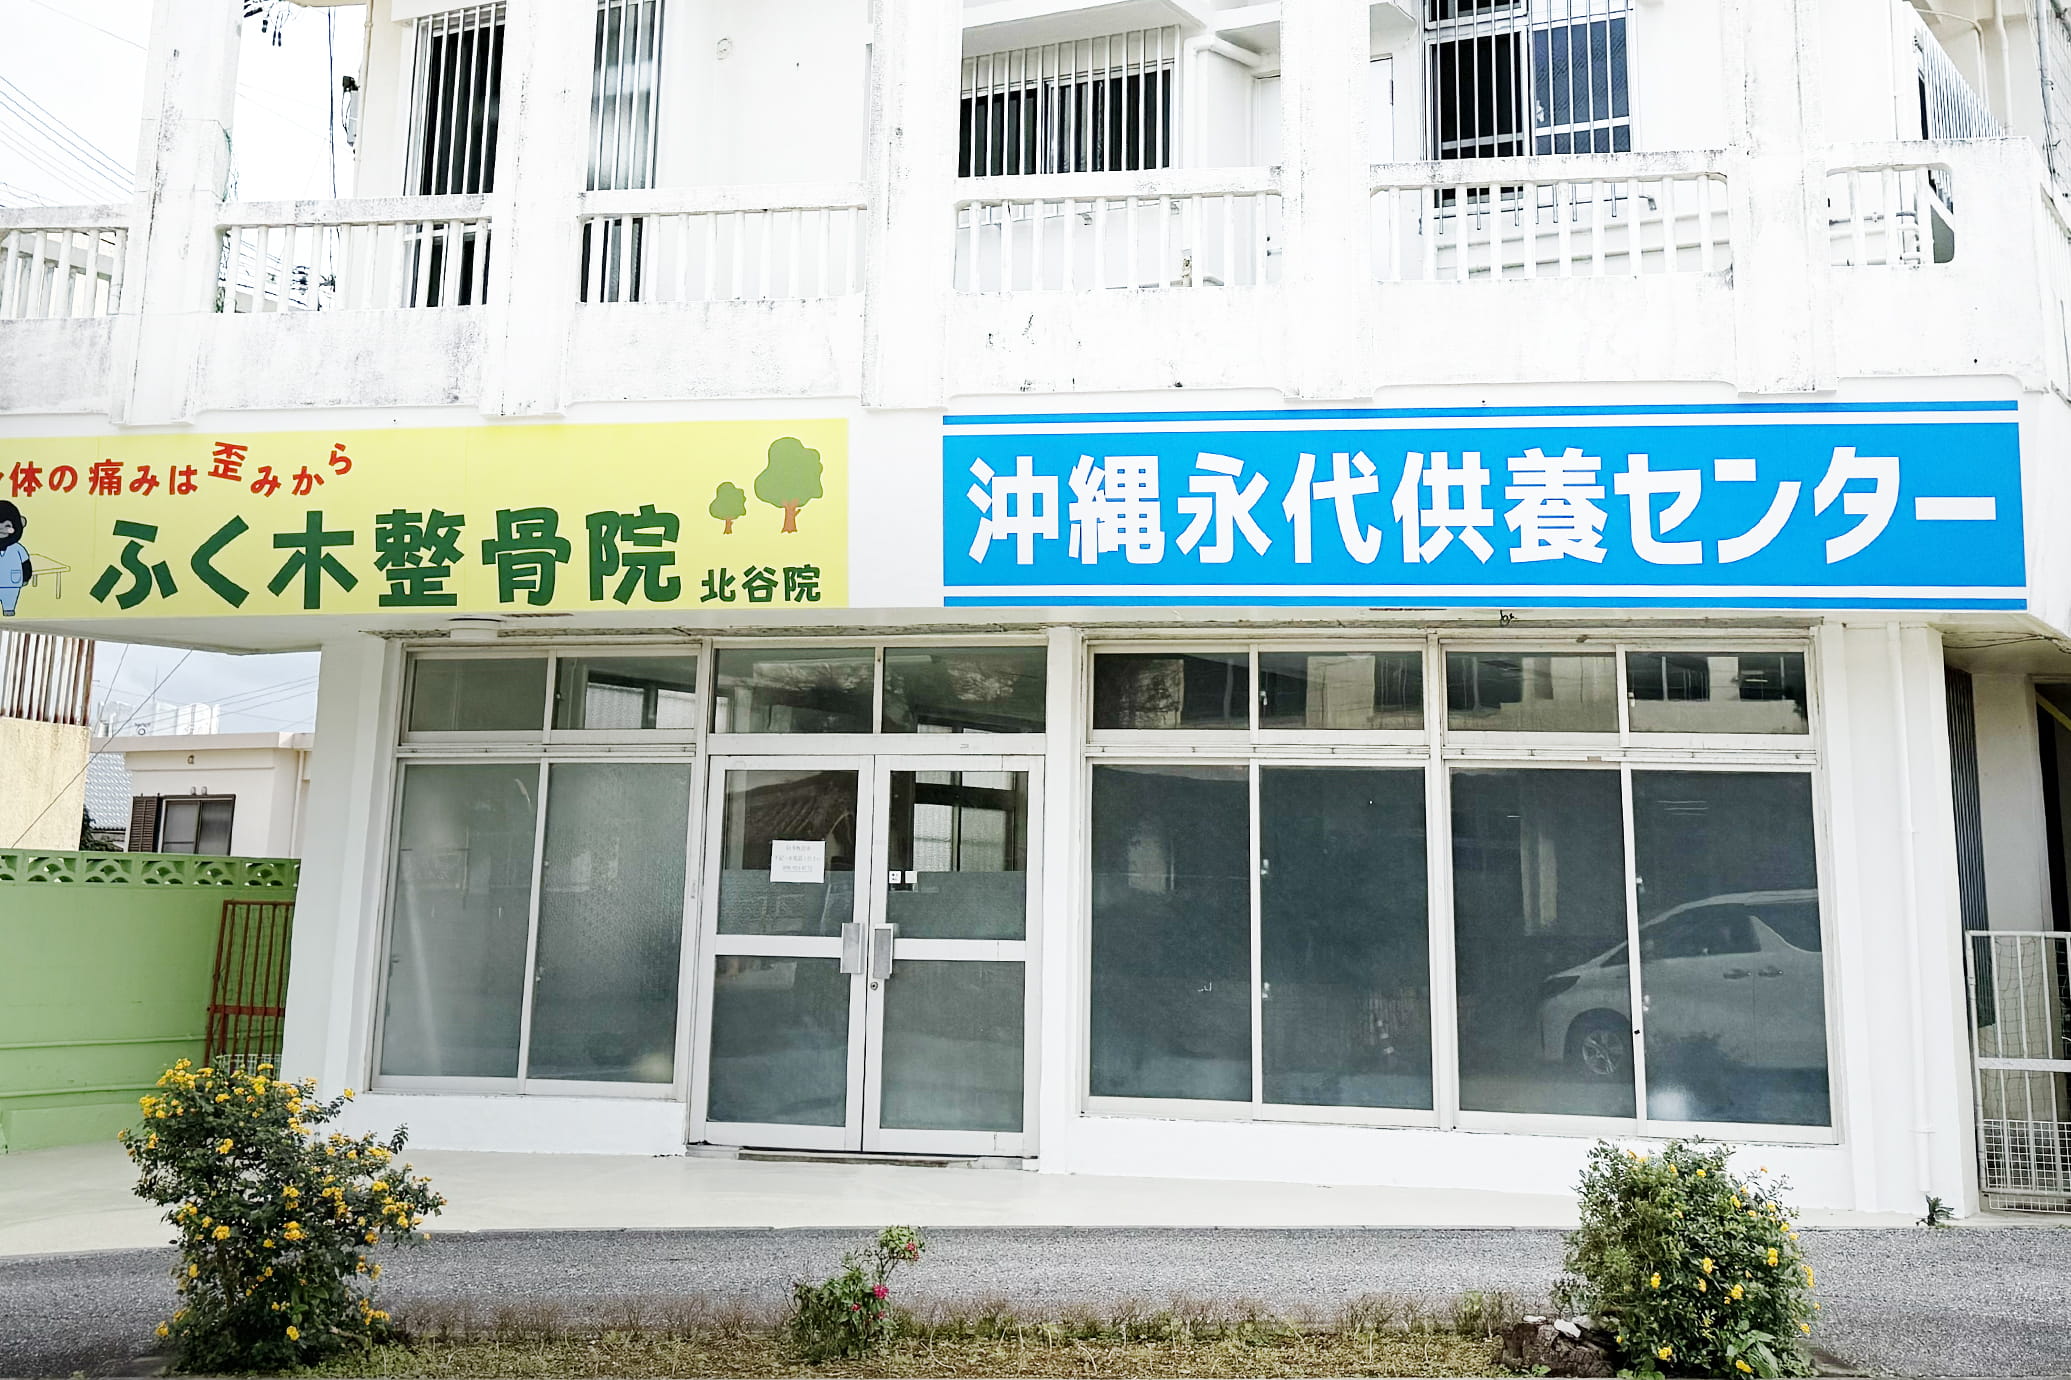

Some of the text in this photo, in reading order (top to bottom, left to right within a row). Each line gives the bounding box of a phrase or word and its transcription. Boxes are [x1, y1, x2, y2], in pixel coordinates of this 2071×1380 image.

[0, 441, 353, 498] 体の痛みは歪みから
[966, 446, 1998, 565] 沖縄永代供養センター
[89, 503, 682, 610] ふく木整骨院
[699, 563, 822, 603] 北谷院
